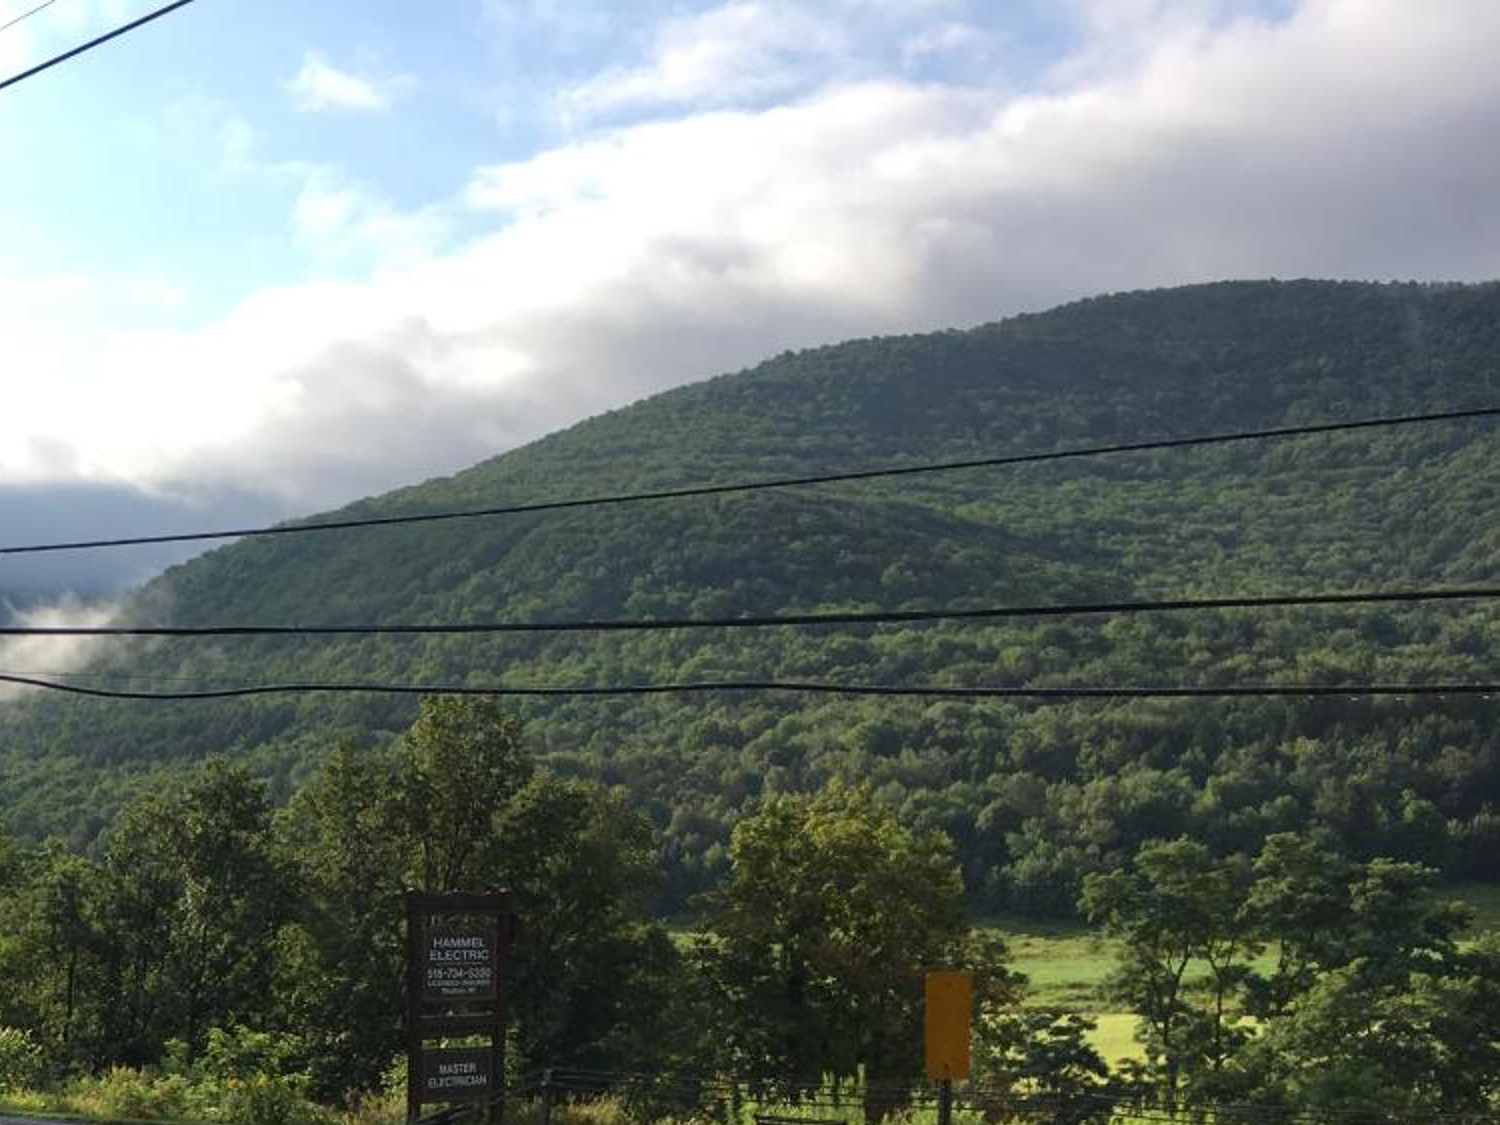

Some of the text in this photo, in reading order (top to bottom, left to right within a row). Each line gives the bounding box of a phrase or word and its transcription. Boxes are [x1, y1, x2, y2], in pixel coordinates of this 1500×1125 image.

[433, 936, 486, 948] HAMMEL
[429, 949, 489, 961] ELECTRIC
[439, 1063, 477, 1075] MASTER
